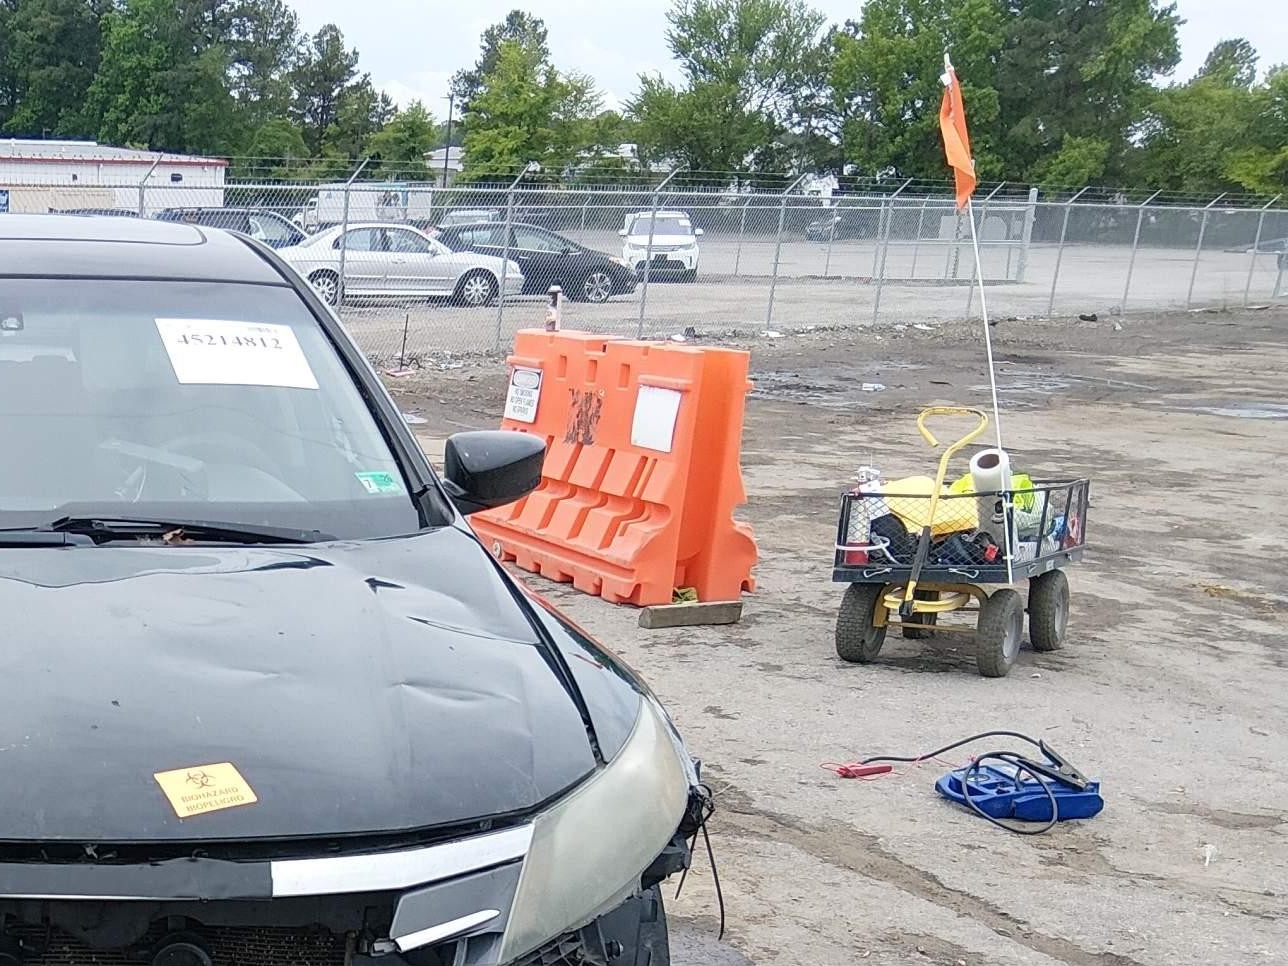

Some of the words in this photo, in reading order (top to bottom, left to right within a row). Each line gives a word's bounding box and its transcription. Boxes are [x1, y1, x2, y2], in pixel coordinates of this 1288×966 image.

[177, 333, 284, 350] 45214812
[181, 787, 239, 803] BIOHAZARD
[186, 795, 245, 812] BIOPELIGRO
